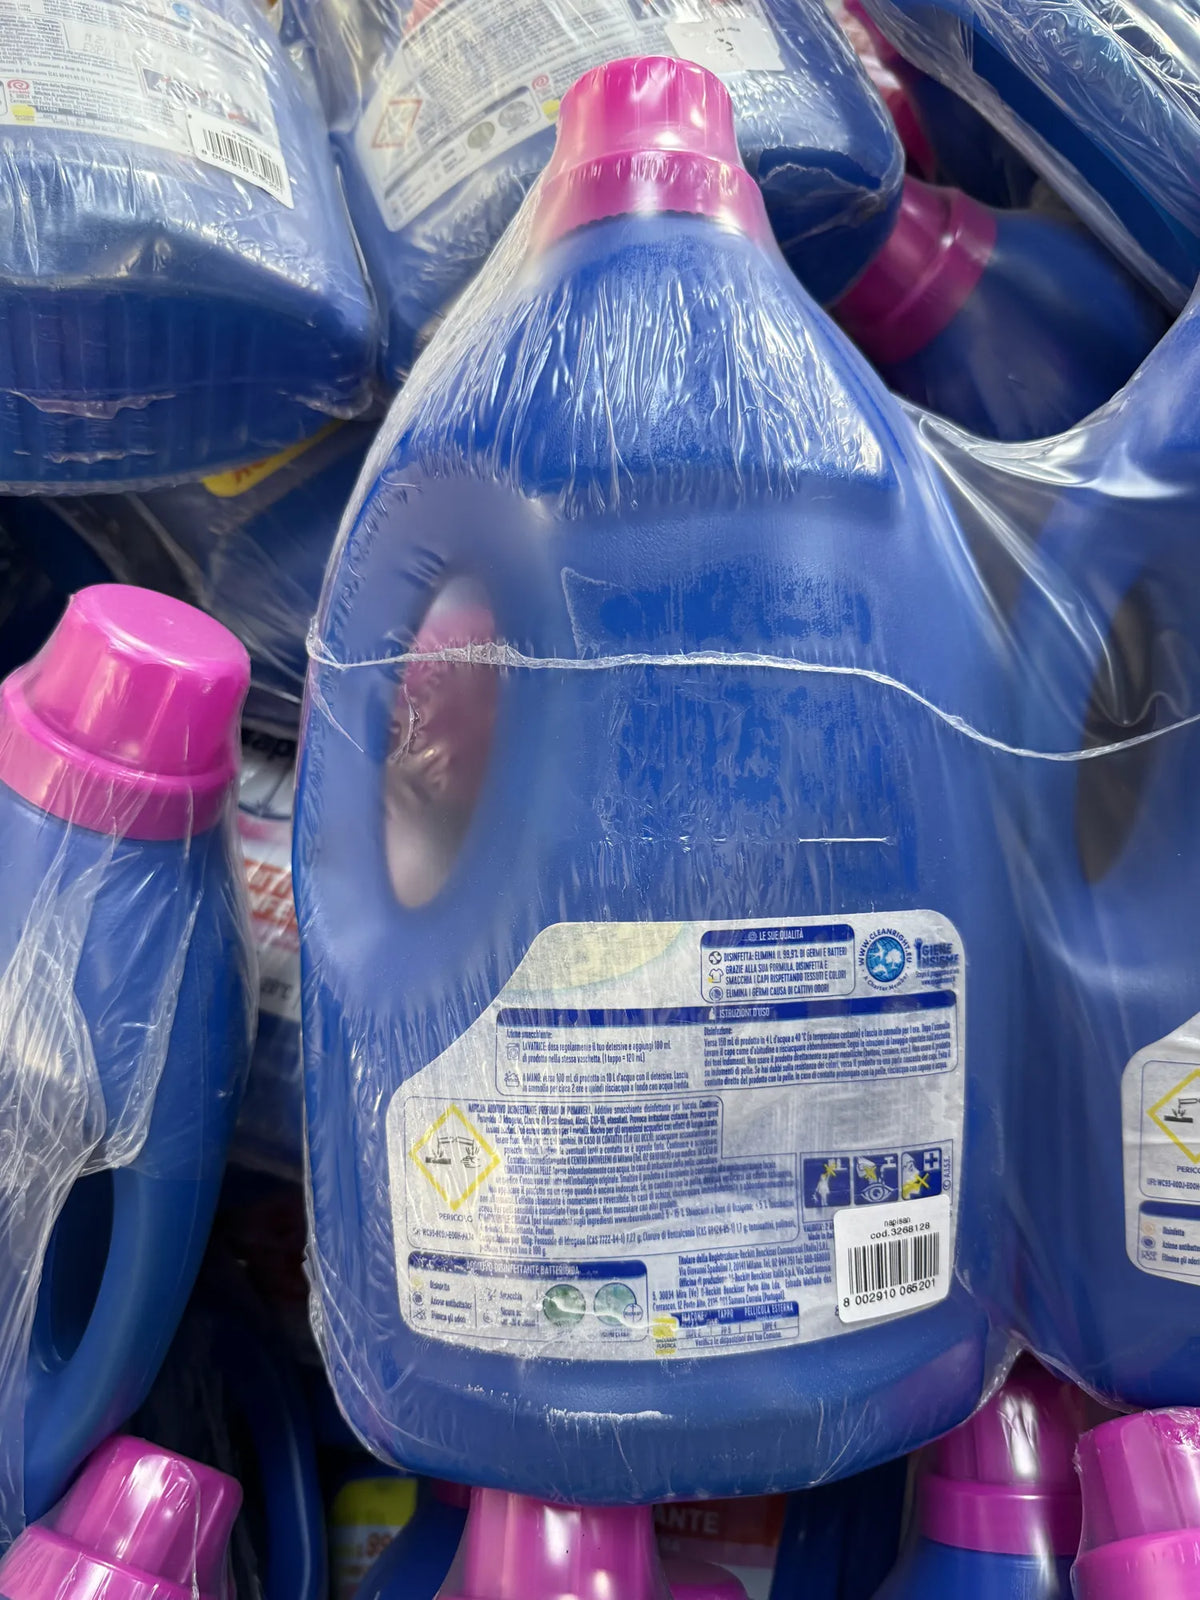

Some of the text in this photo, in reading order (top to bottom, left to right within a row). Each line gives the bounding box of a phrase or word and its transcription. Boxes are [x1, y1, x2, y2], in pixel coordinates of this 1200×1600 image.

[760, 928, 804, 941] LE SUE QUALITÀ
[724, 952, 754, 962] DISINFETTA:
[755, 950, 776, 960] ELIMINA
[783, 949, 798, 959] 99,9%
[800, 948, 805, 958] DI
[806, 948, 822, 957] GERMI
[823, 948, 826, 956] E
[827, 947, 847, 956] BATTERI
[858, 928, 912, 966] WWW.CLEANRIGHT.EU
[726, 965, 743, 975] GRAZIE
[745, 964, 757, 973] ALLA
[758, 963, 768, 972] SUA
[796, 961, 823, 970] DISINFETTA
[824, 960, 828, 969] E
[726, 976, 752, 985] SMACCHIA
[757, 975, 769, 984] CAPI
[770, 972, 804, 983] RISPETTANDO
[805, 971, 824, 981] TESSUTI
[825, 971, 828, 980] E
[829, 970, 846, 979] COLORI
[868, 980, 888, 991] Charter
[889, 973, 909, 990] Member
[726, 988, 748, 998] ELIMINA
[752, 986, 769, 997] GERMI
[770, 986, 787, 996] CAUSA
[788, 985, 793, 995] DI
[794, 984, 813, 994] CATTIVI
[814, 983, 829, 993] ODORI
[720, 1007, 770, 1018] ISTRUZIONI D'USO
[704, 1031, 840, 1047] Versa prodotto d'acqua temperatura
[560, 1042, 592, 1053] regolarmente
[605, 1041, 628, 1050] detersivo
[632, 1041, 654, 1052] aggiungi
[724, 1049, 735, 1058] capo
[527, 1054, 548, 1065] prodotto
[548, 1054, 561, 1063] nella
[561, 1054, 576, 1063] stessa
[607, 1054, 622, 1065] tappo
[578, 1073, 600, 1084] prodotto
[616, 1072, 635, 1084] d'acqua
[650, 1072, 673, 1081] detersivo.
[674, 1071, 688, 1080] Lascia
[549, 1086, 558, 1095] per
[558, 1084, 571, 1093] circa
[588, 1083, 604, 1094] quindi
[604, 1082, 630, 1094] risciacqua
[634, 1082, 648, 1091] fondo
[658, 1083, 673, 1092] acqua
[673, 1080, 690, 1090] fredda.
[884, 1217, 911, 1227] napisan
[870, 1222, 930, 1239] cod.3268128
[1162, 1241, 1177, 1250] Azione
[678, 1254, 696, 1264] Titolare
[696, 1253, 708, 1263] della
[708, 1250, 739, 1264] Registrazione:
[739, 1249, 755, 1259] Reckitt
[755, 1247, 777, 1258] Benckiser
[777, 1244, 803, 1256] Commercial
[1162, 1253, 1179, 1263] Elimina
[493, 1264, 539, 1275] DISINFETTANTE
[686, 1264, 707, 1275] Giovanni
[706, 1262, 728, 1275] Spadolini
[678, 1276, 696, 1287] Officina
[750, 1270, 772, 1281] Benckiser
[676, 1289, 687, 1299] Mira
[723, 1283, 745, 1294] Benckiser
[746, 1282, 759, 1292] Porto
[760, 1281, 770, 1291] Alto
[784, 1278, 801, 1288] Estrada
[823, 1274, 832, 1284] dos
[843, 1278, 935, 1307] 8 002910 065201
[683, 1299, 695, 1309] Porto
[745, 1292, 762, 1303] Correia
[718, 1309, 734, 1319] TAPPO
[744, 1305, 771, 1316] PELLICOLA
[772, 1303, 794, 1313] ESTERNA
[719, 1334, 747, 1347] disposizioni
